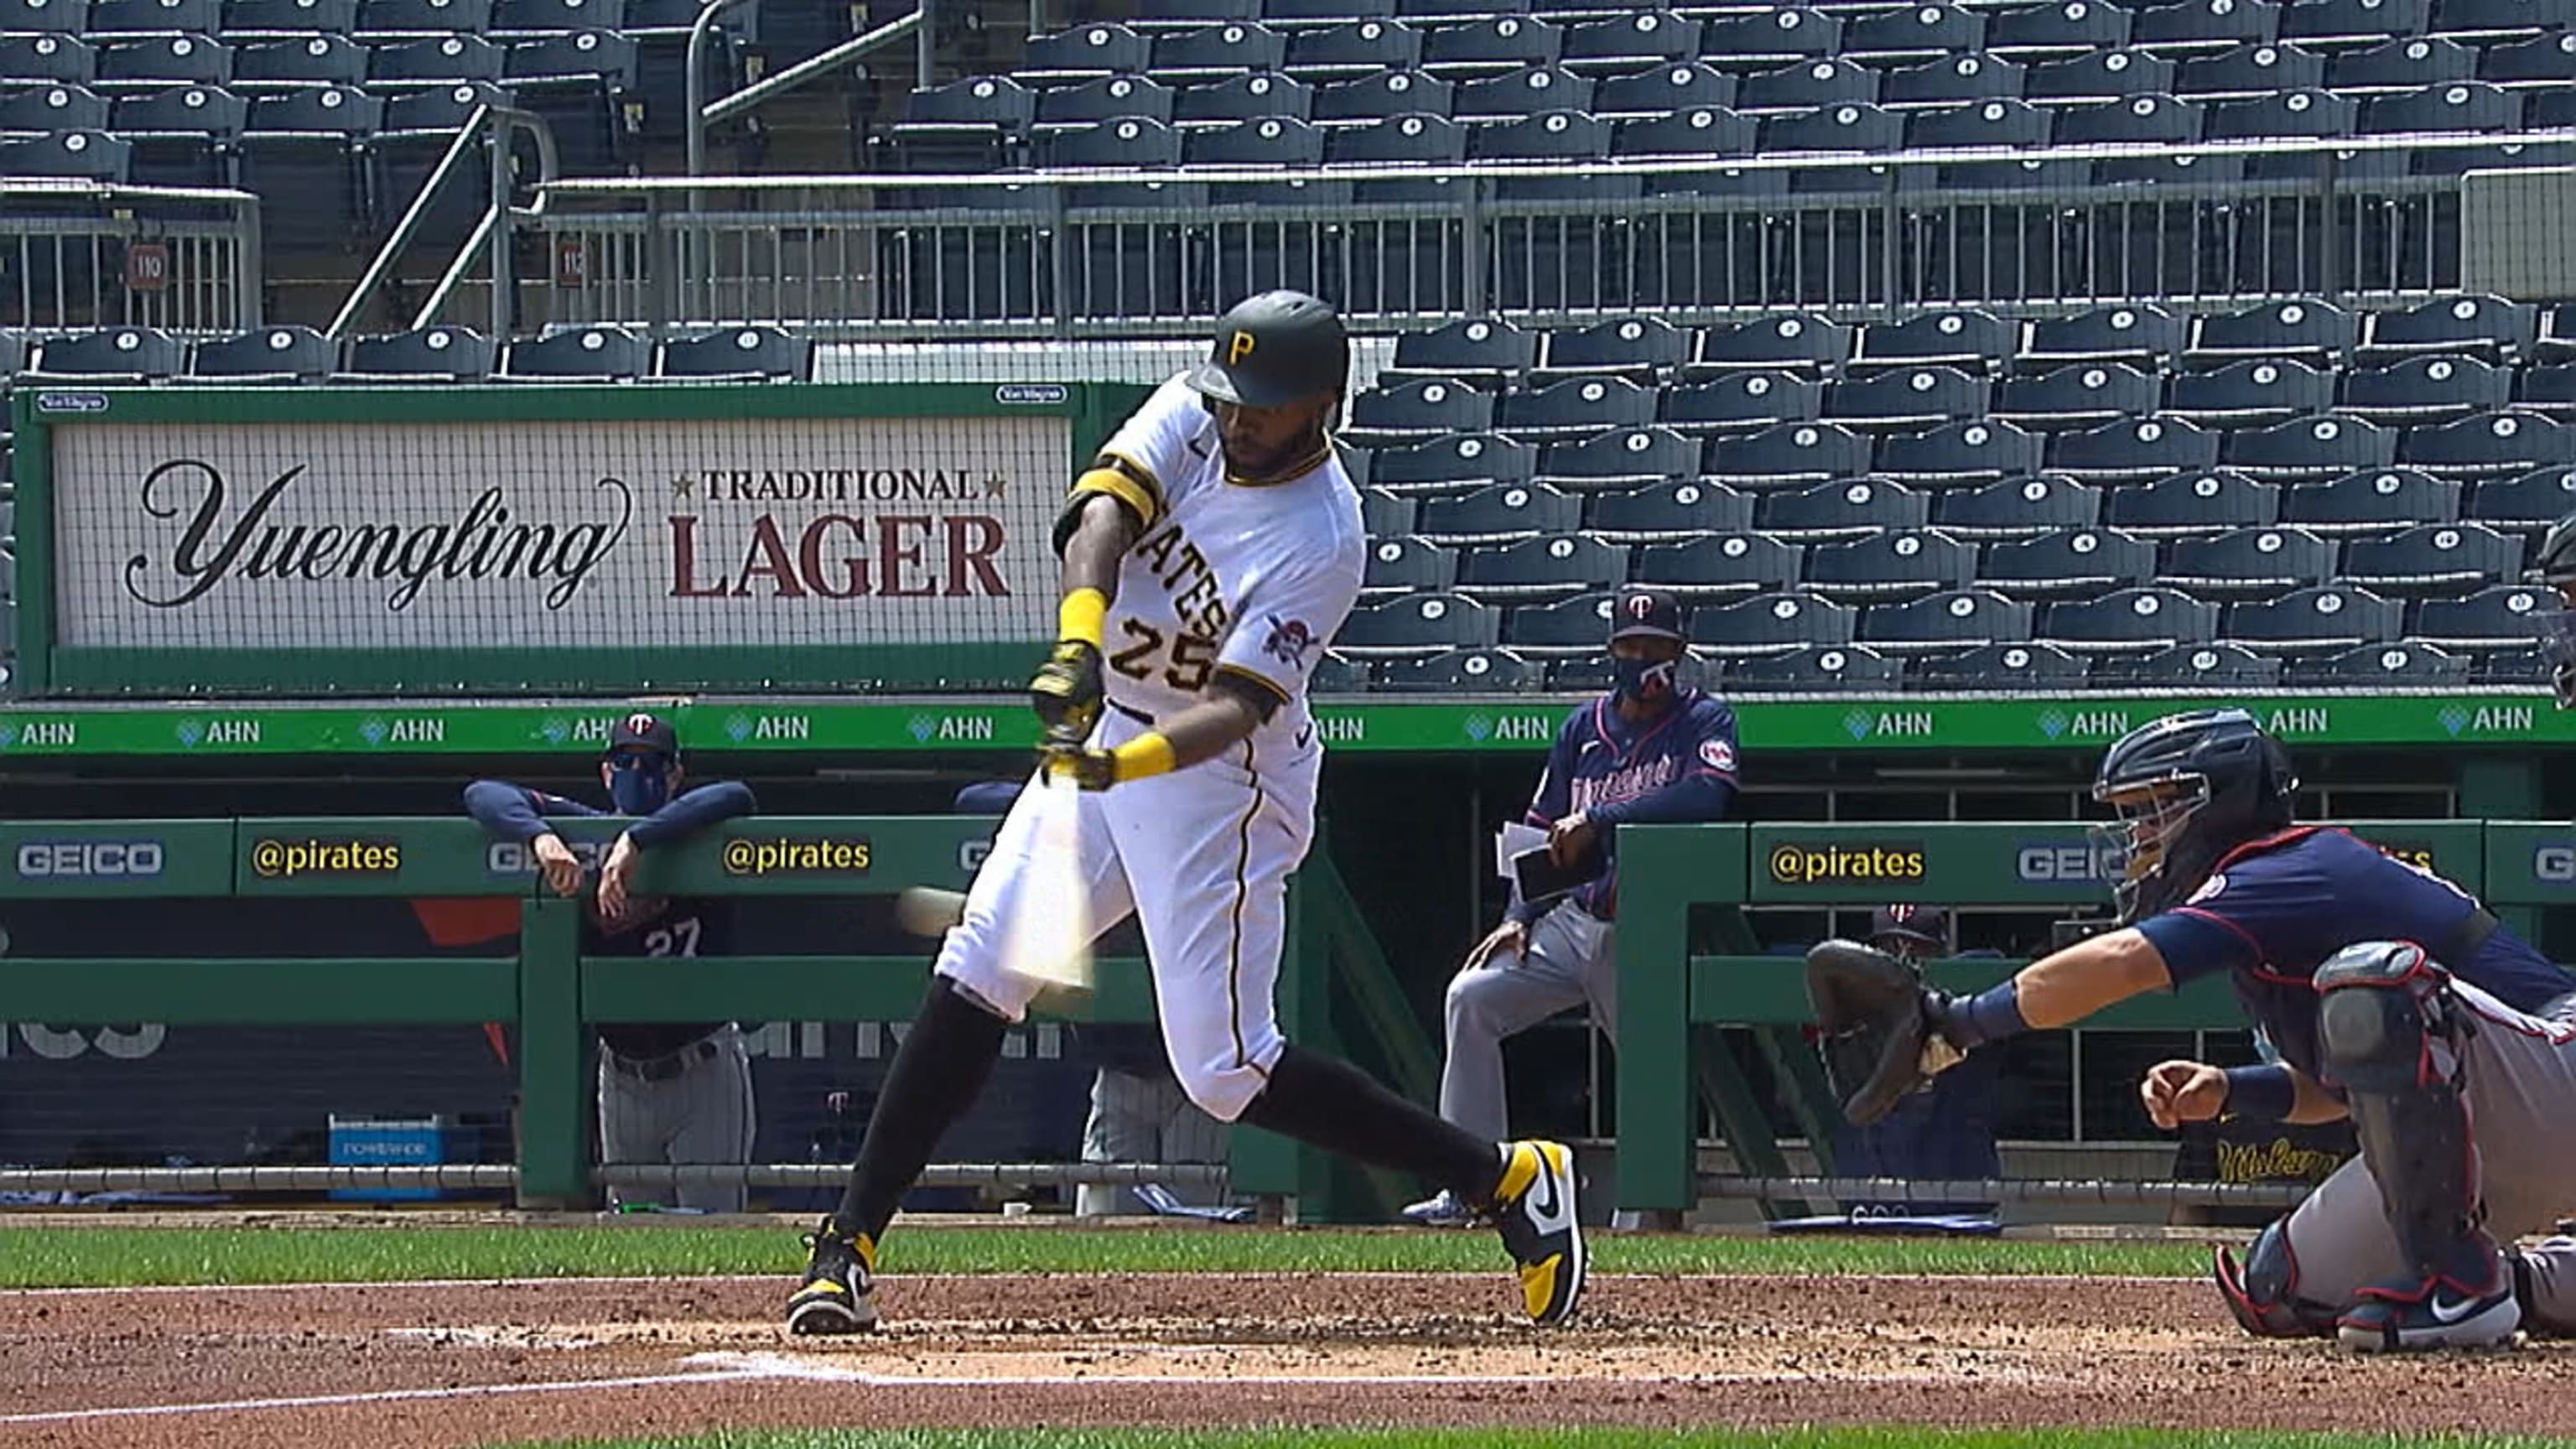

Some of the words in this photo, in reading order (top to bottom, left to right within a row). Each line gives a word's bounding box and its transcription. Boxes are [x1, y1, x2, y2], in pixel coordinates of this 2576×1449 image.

[138, 254, 162, 278] 110
[1229, 331, 1255, 366] P
[701, 469, 979, 501] TRADITIONAL
[125, 458, 633, 611] Yuengling
[668, 514, 1010, 600] LAGER
[1135, 523, 1228, 641] ATES
[1109, 617, 1216, 693] 25
[22, 724, 75, 744] AHN
[207, 721, 259, 742] AHN
[391, 719, 444, 741] AHN
[756, 717, 808, 739] AHN
[939, 717, 992, 739] AHN
[1495, 717, 1549, 739] AHN
[1877, 712, 1932, 735] AHN
[2071, 712, 2128, 735] AHN
[2270, 709, 2327, 732] AHN
[2473, 706, 2532, 730] AHN
[17, 844, 164, 876] GEICO
[252, 839, 400, 876] @pirates
[723, 837, 870, 875] @pirates
[1770, 844, 1924, 882] @pirates
[2018, 847, 2132, 879] GEIC
[644, 916, 701, 958] 27
